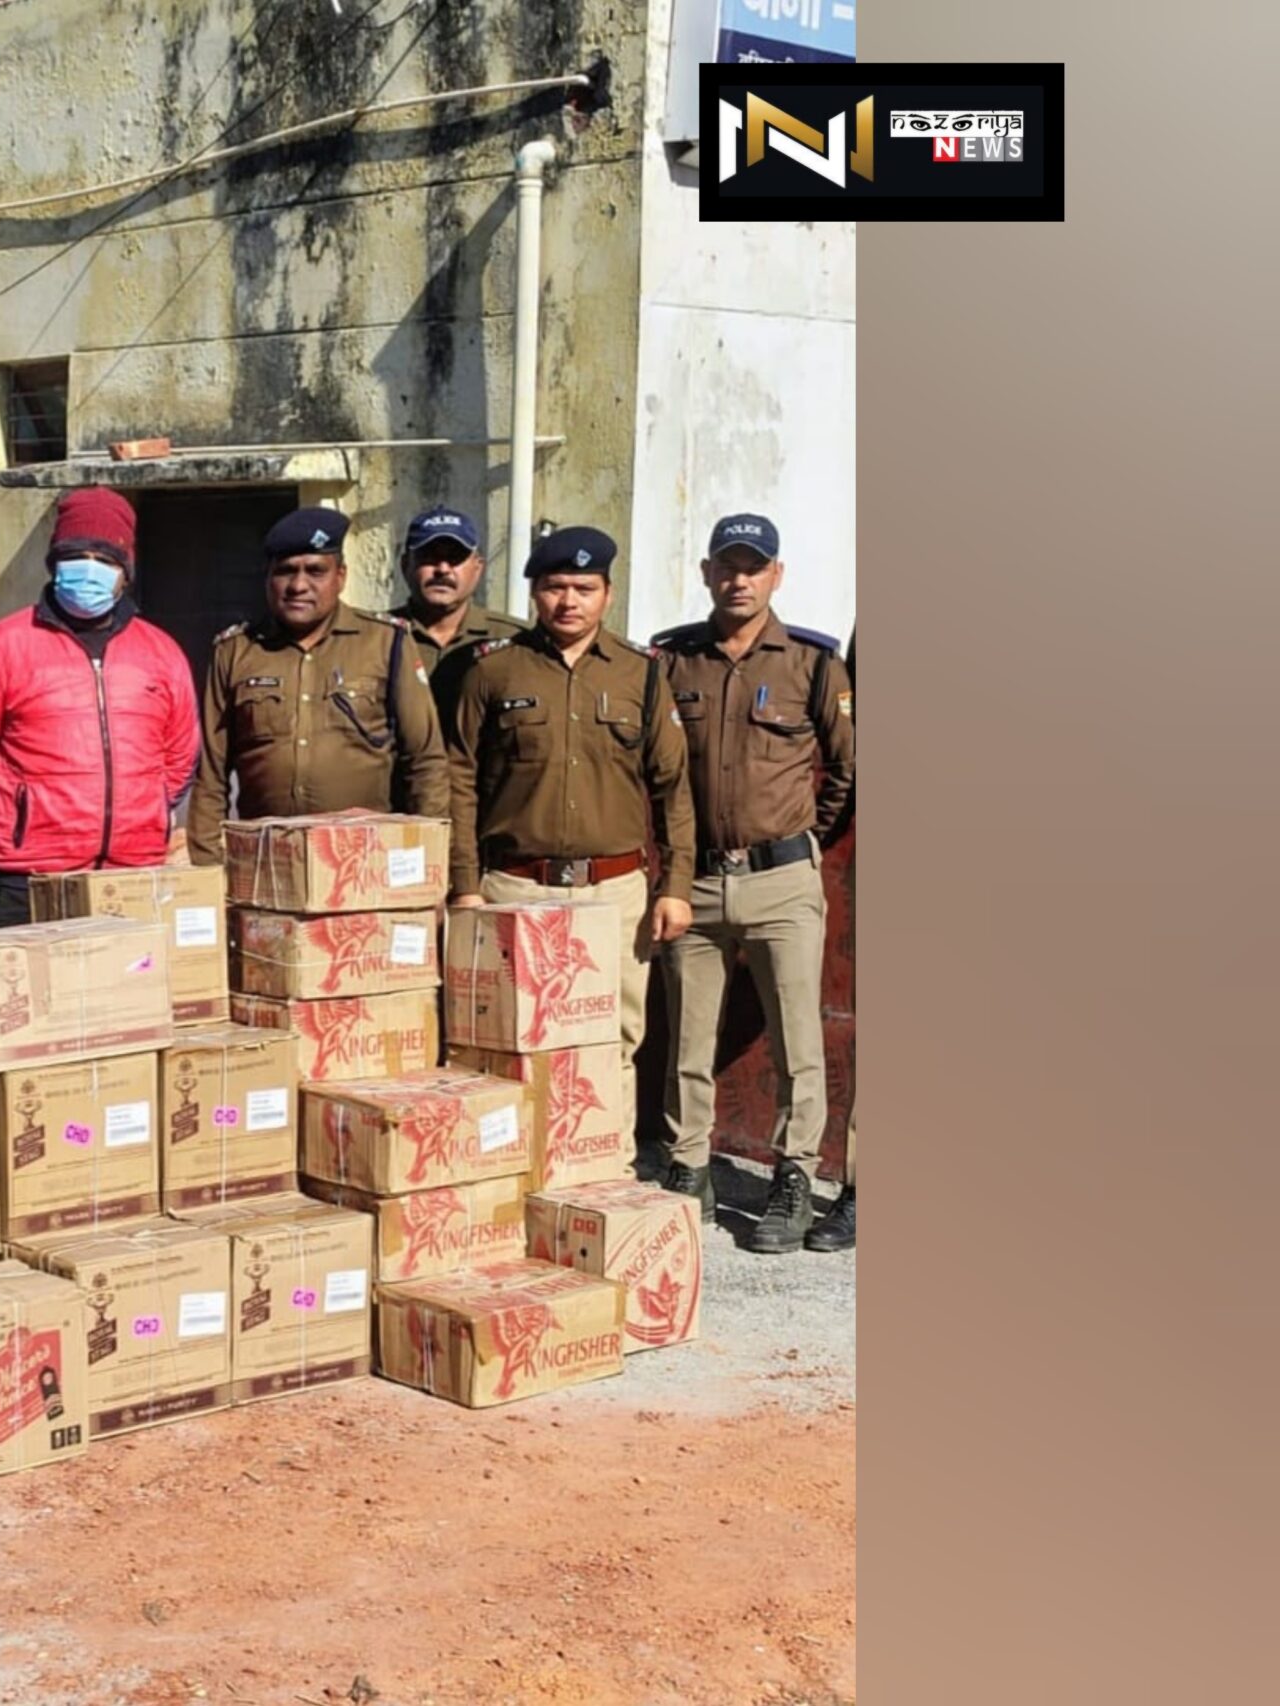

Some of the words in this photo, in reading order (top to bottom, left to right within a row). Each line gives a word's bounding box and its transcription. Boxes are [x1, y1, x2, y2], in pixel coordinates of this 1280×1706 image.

[423, 515, 462, 527] POLICE
[723, 523, 762, 537] POLICE
[547, 993, 616, 1023] KINGFISHER
[552, 1132, 621, 1163] KINGFISHER
[428, 1222, 521, 1260] KINGFISHER
[524, 1332, 620, 1378] KINGFISHER
